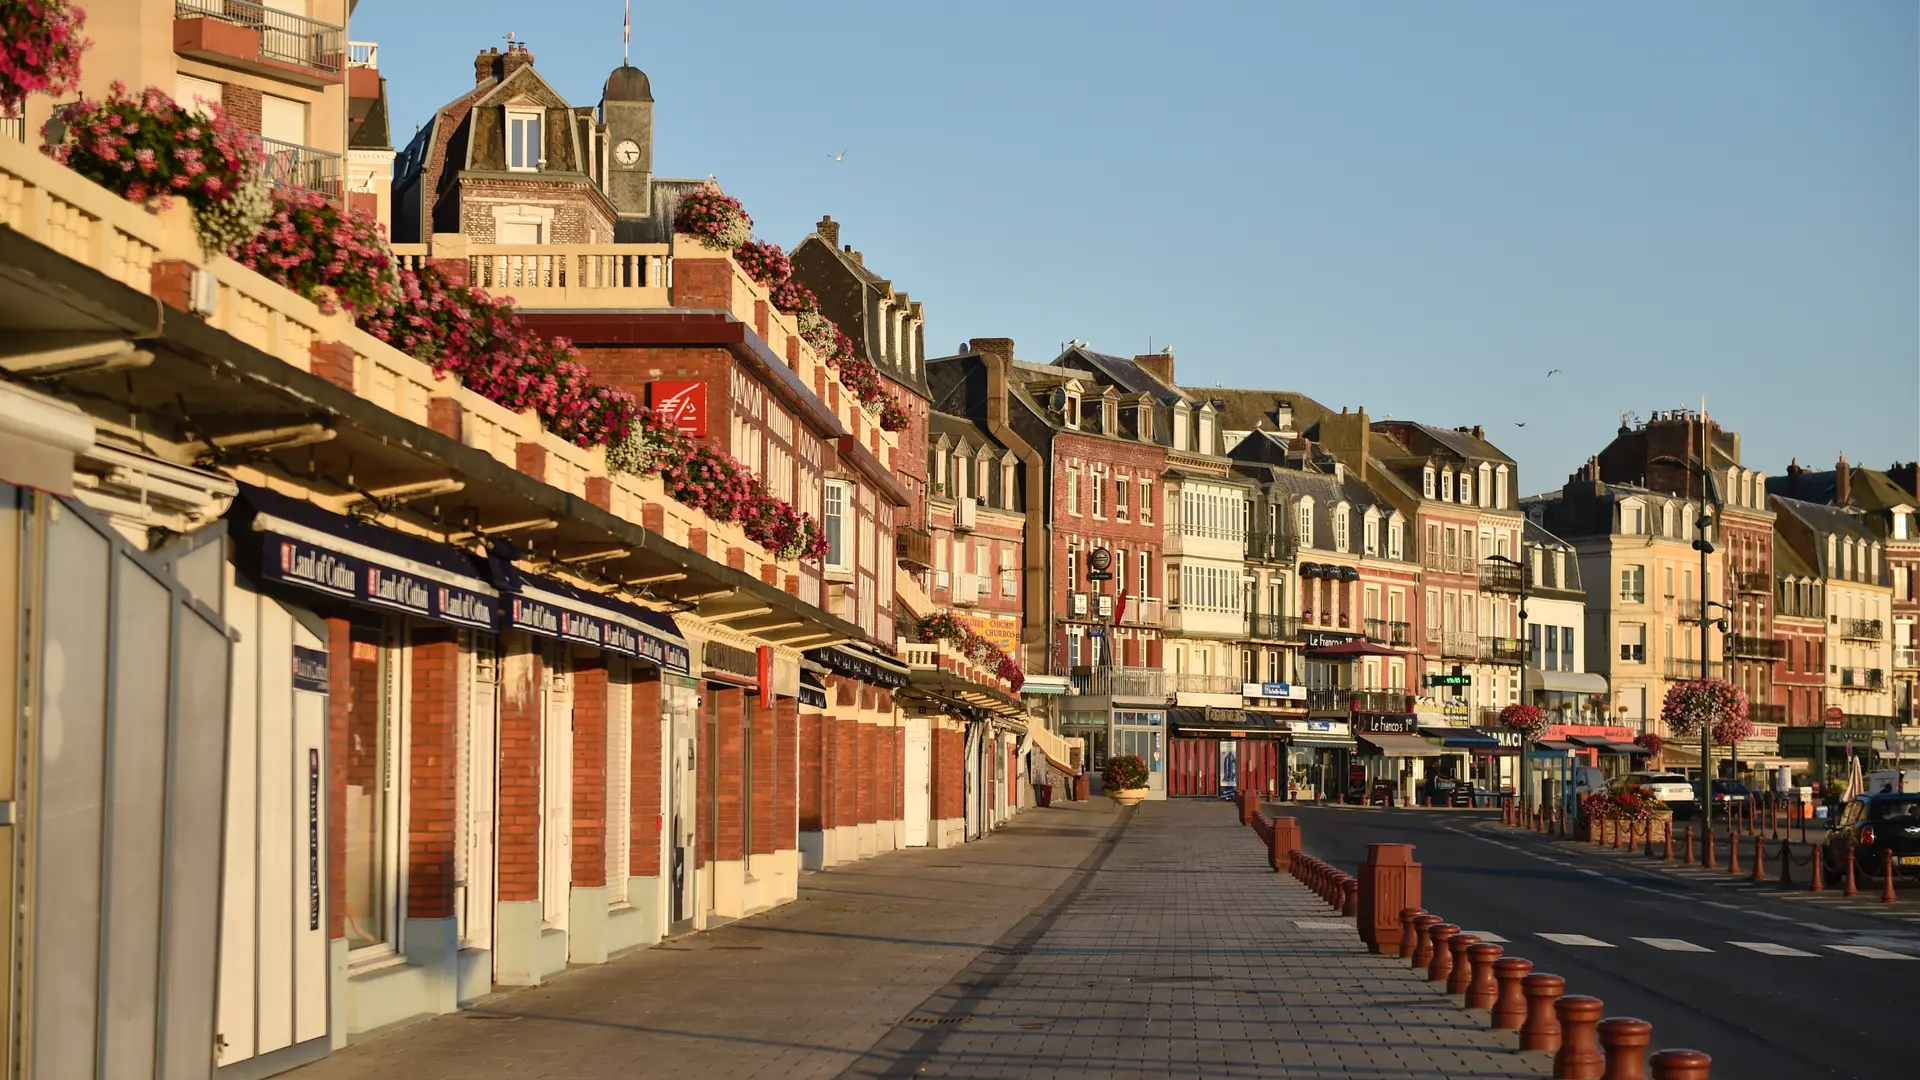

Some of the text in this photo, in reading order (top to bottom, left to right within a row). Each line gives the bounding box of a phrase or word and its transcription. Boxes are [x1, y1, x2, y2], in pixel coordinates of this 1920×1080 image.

[290, 545, 356, 591] Land of Cotton
[376, 569, 429, 609] Land of Cotton
[445, 588, 491, 623] Land of Cotton
[518, 599, 558, 632] Land of Cotton
[985, 629, 1015, 638] CHURROS
[1309, 633, 1318, 646] Le
[1370, 716, 1379, 732] Le
[1405, 718, 1413, 732] 1er
[1761, 728, 1777, 738] PRESSE
